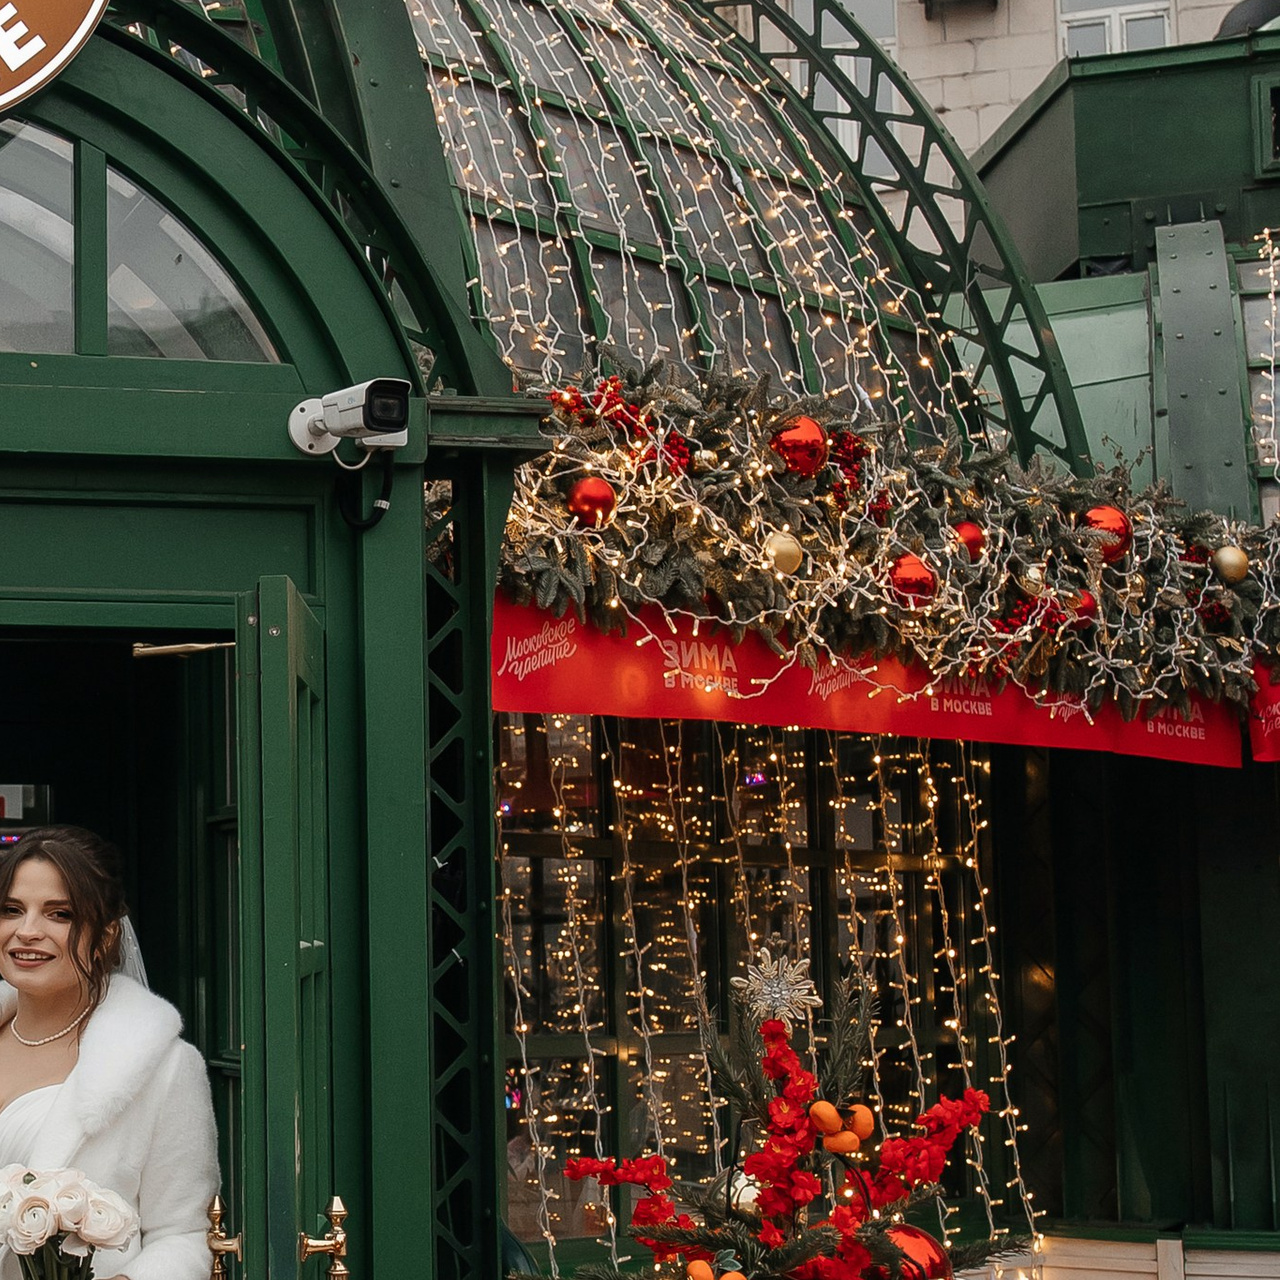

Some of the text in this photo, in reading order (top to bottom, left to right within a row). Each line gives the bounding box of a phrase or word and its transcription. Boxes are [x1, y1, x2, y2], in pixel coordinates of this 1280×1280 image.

[496, 617, 576, 677] Московское
[662, 639, 738, 673] ЗИМА
[930, 697, 993, 717] В МОСКВЕ
[1146, 720, 1206, 740] В МОСКВЕ
